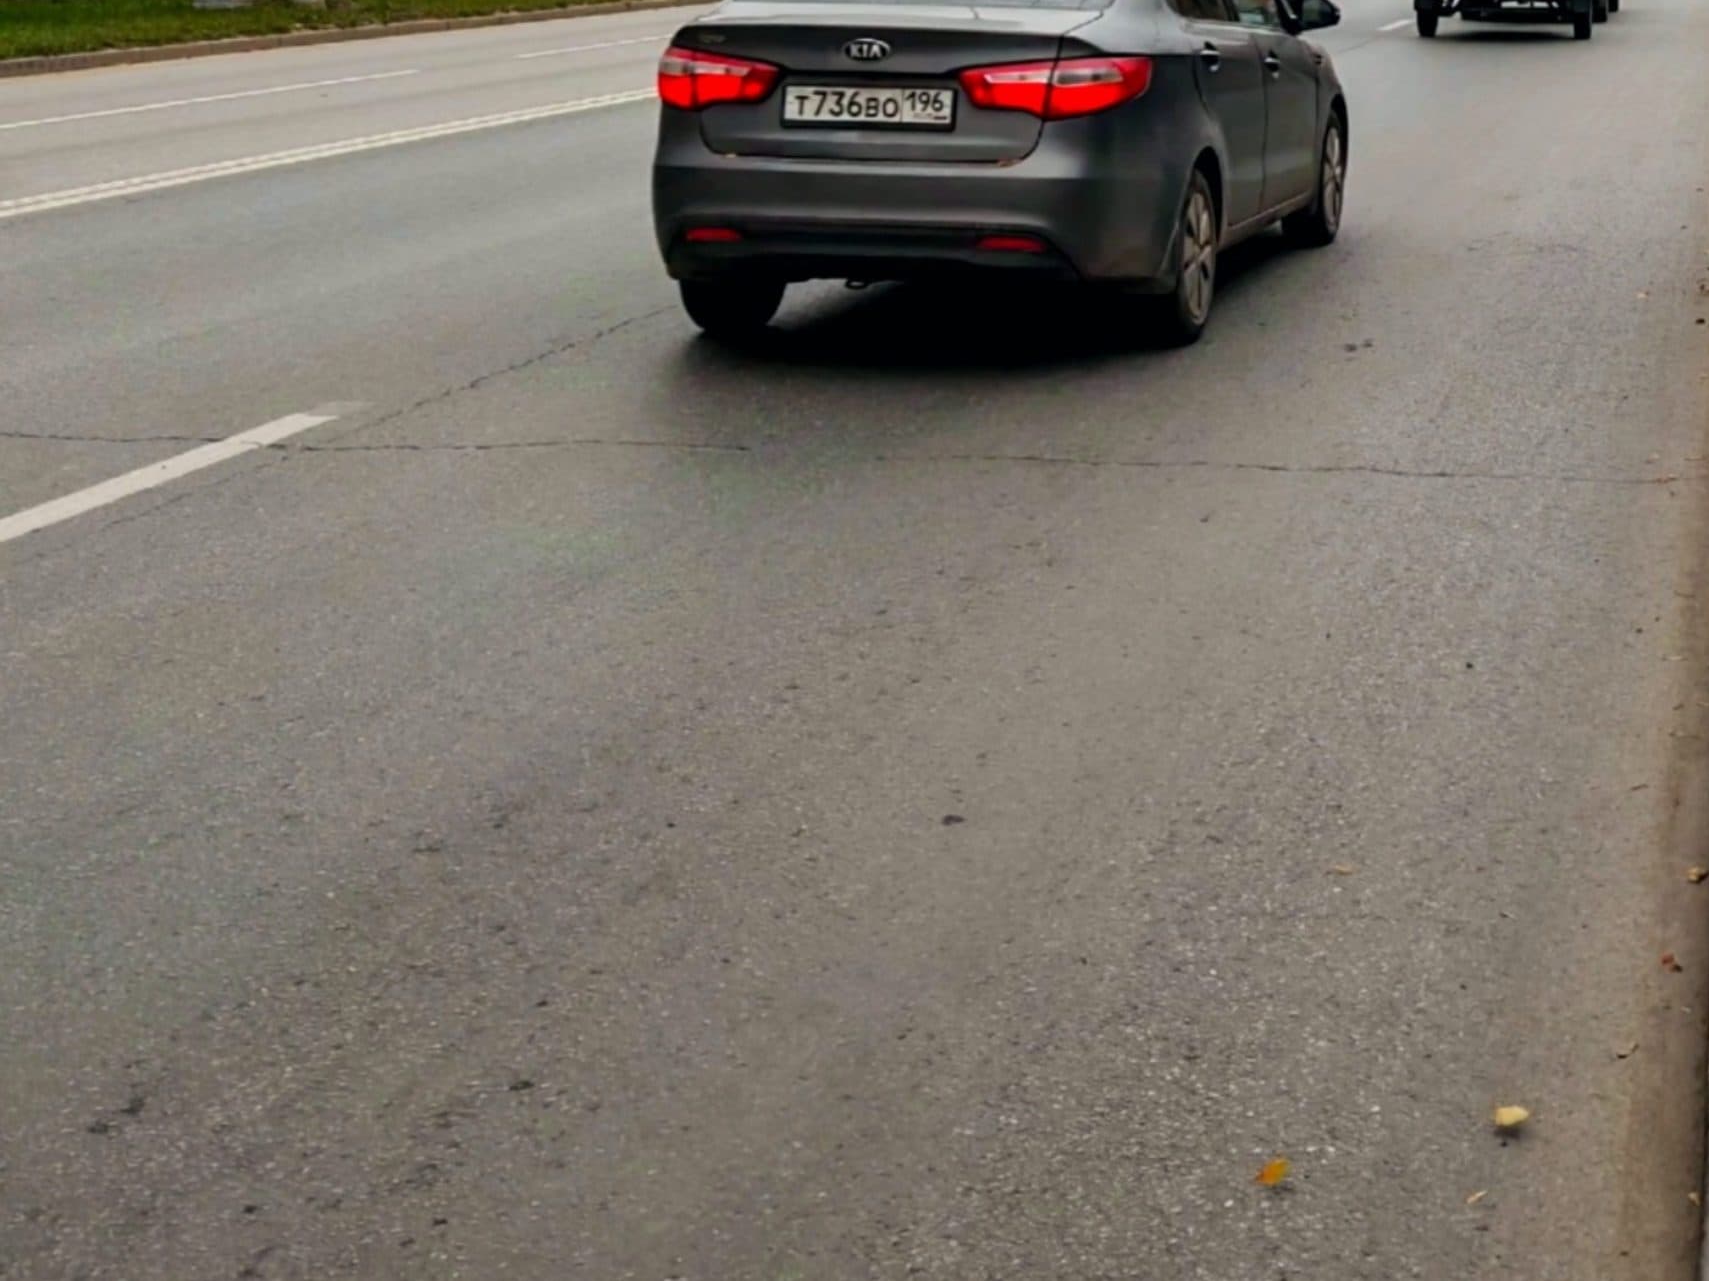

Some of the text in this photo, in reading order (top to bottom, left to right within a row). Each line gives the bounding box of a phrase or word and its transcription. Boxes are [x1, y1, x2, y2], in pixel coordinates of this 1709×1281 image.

[849, 43, 882, 59] KIA
[794, 90, 944, 118] Т736ВО 196
